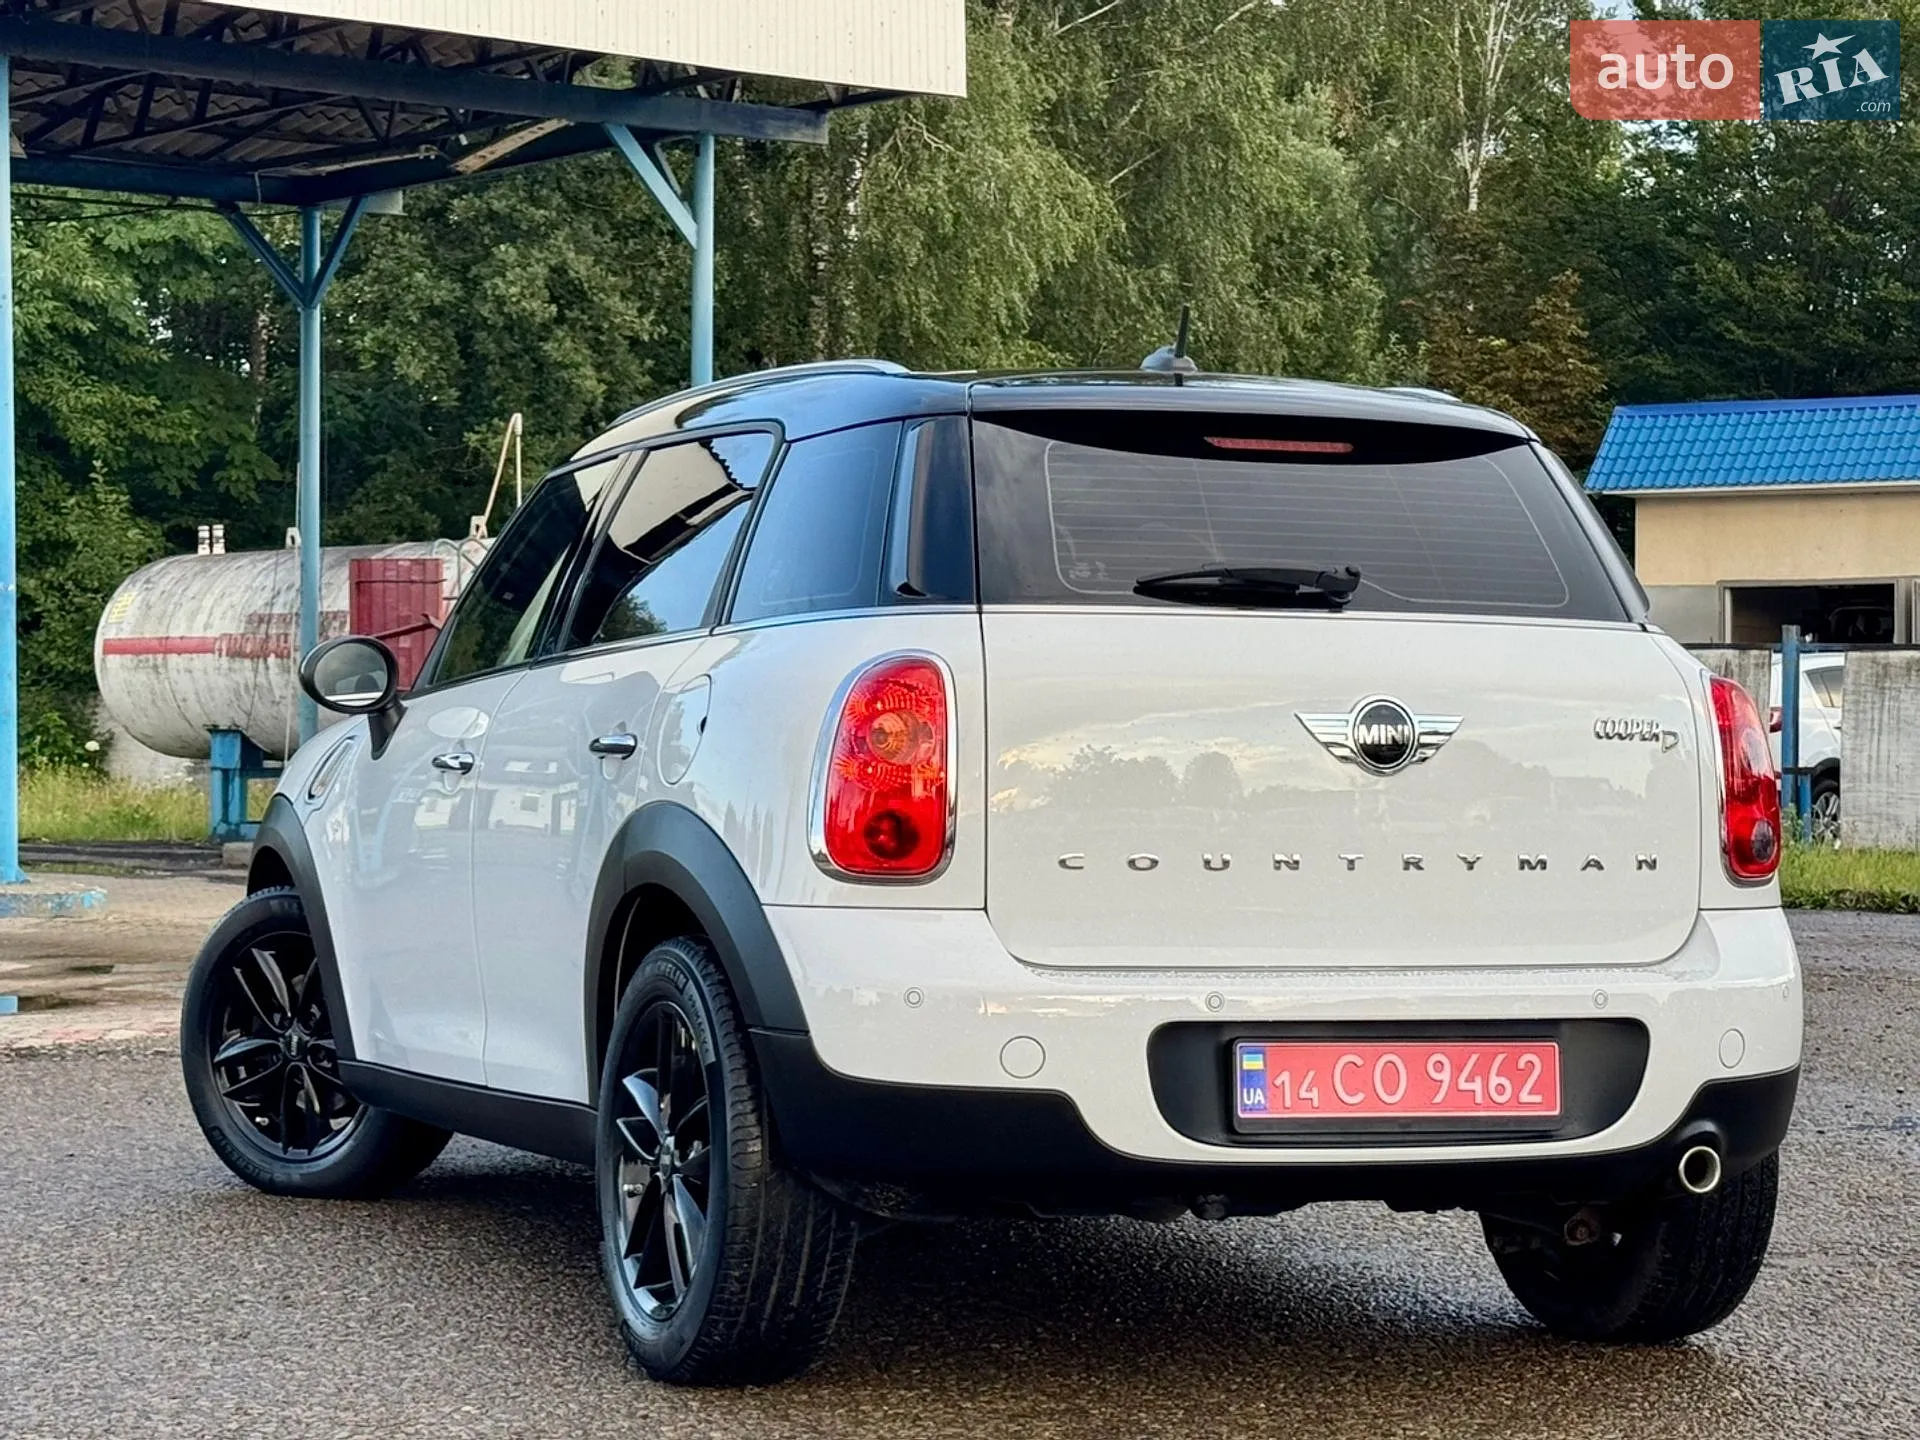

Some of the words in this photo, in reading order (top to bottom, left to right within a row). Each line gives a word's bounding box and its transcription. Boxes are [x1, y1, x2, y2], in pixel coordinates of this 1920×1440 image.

[1358, 724, 1410, 745] MINI
[1594, 717, 1660, 741] COOPER
[1661, 730, 1679, 753] D
[1057, 852, 1659, 872] COUNTRYMAN
[1273, 1070, 1319, 1109] 14
[1332, 1053, 1408, 1105] CO
[1425, 1053, 1543, 1105] 9462
[1243, 1087, 1265, 1105] UA
